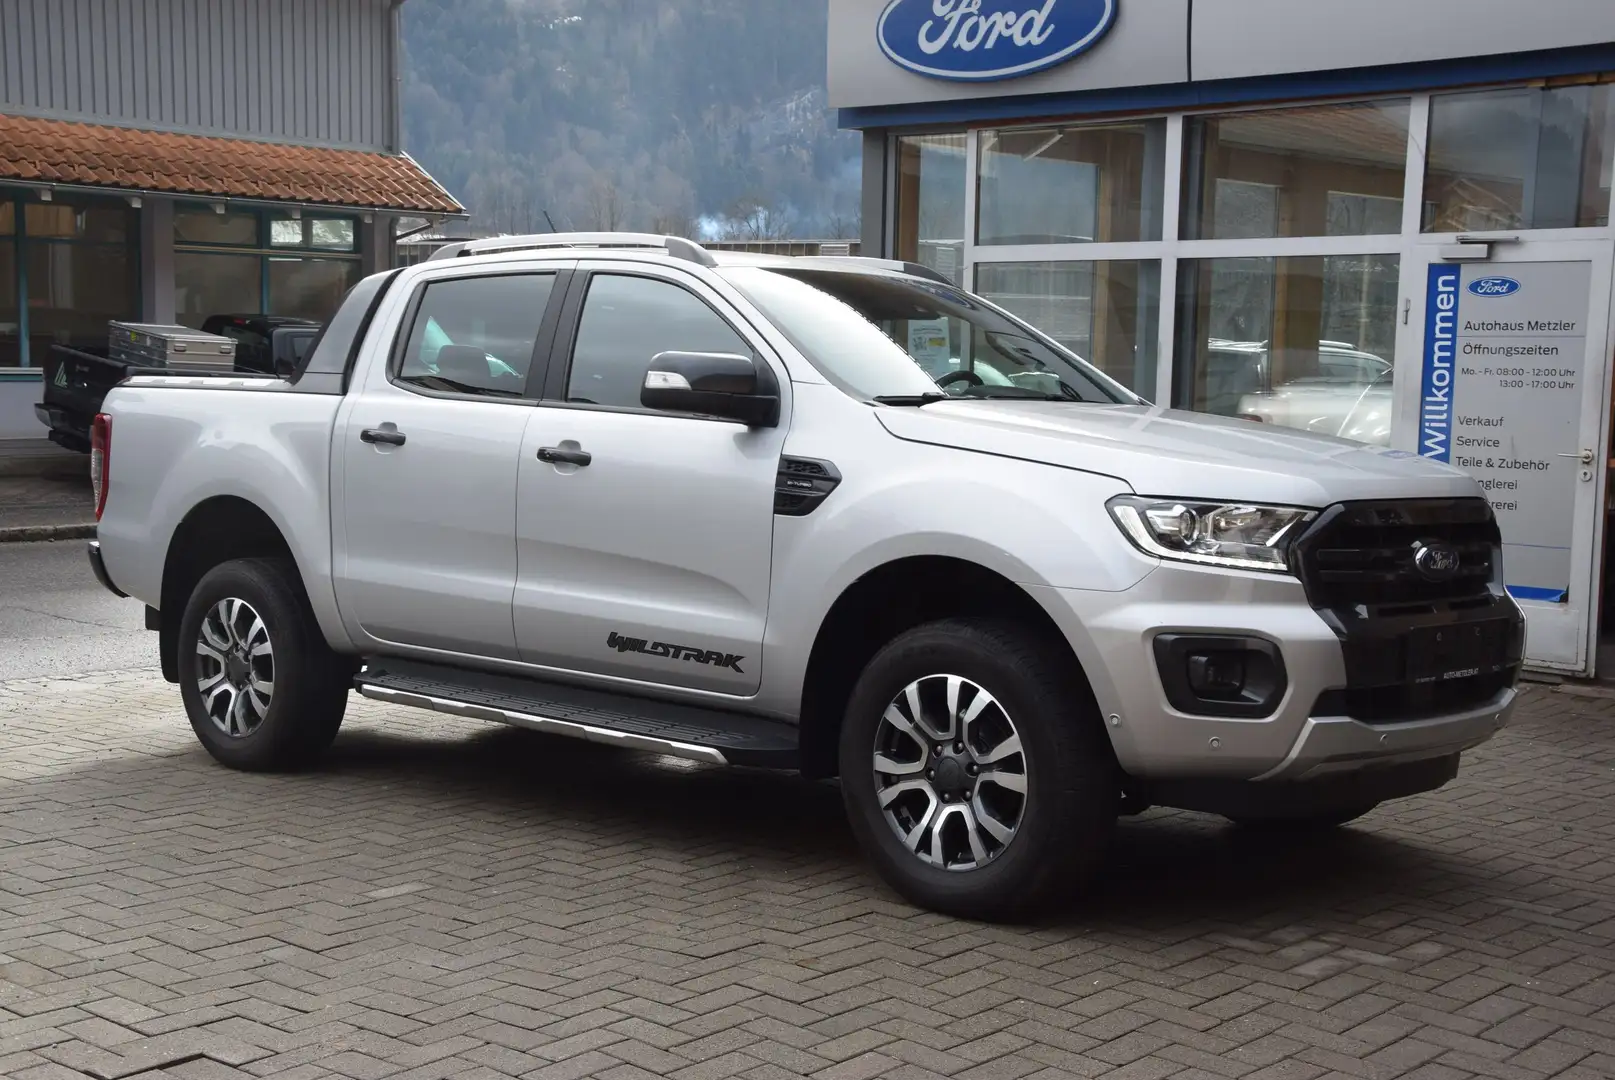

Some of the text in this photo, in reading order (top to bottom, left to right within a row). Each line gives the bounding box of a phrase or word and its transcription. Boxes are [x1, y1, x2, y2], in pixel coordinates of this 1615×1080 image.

[918, 0, 1055, 54] Ford
[1477, 280, 1509, 293] Ford
[1464, 320, 1576, 331] Autohaus Metzler
[1463, 342, 1559, 357] Öffnungszeiten
[1424, 275, 1456, 458] Willkommen
[1461, 367, 1477, 376] Mo.
[1484, 368, 1494, 376] Fr.
[1496, 368, 1525, 376] 08:00
[1532, 368, 1557, 377] 12:00
[1558, 369, 1576, 377] Uhr
[1499, 380, 1524, 388] 13:00
[1531, 380, 1556, 389] 17:00
[1558, 381, 1575, 389] Uhr
[1458, 416, 1504, 427] Verkauf
[1456, 436, 1500, 447] Service
[1456, 456, 1550, 471] Teile & Zubehör
[606, 631, 747, 674] WILDTRAK
